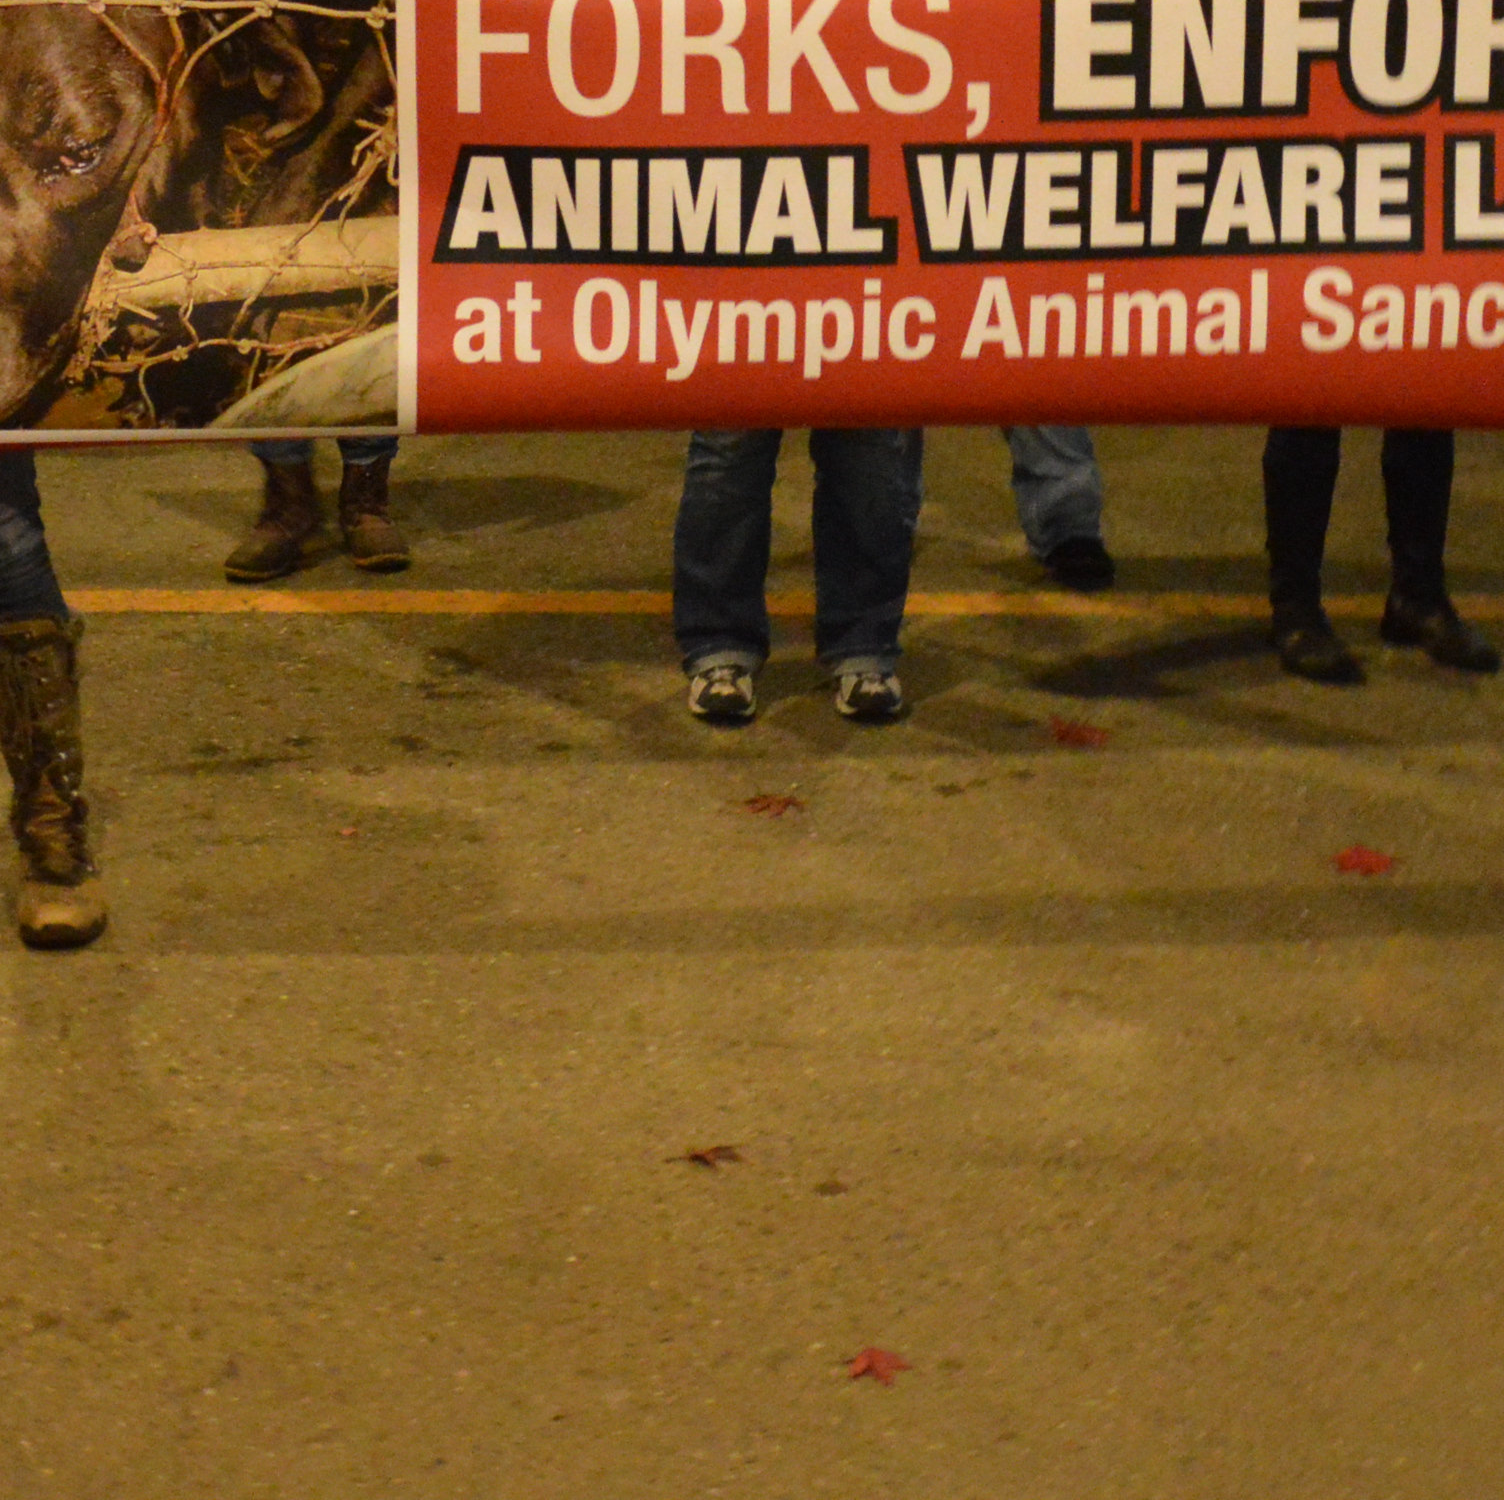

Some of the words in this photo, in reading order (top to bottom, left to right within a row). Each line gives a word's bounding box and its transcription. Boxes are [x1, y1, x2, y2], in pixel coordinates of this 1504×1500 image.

[449, 155, 884, 254] ANIMAL
[918, 142, 1411, 251] WELFARE
[453, 281, 541, 364] at
[572, 278, 935, 381] Olympic
[962, 268, 1268, 359] Animal
